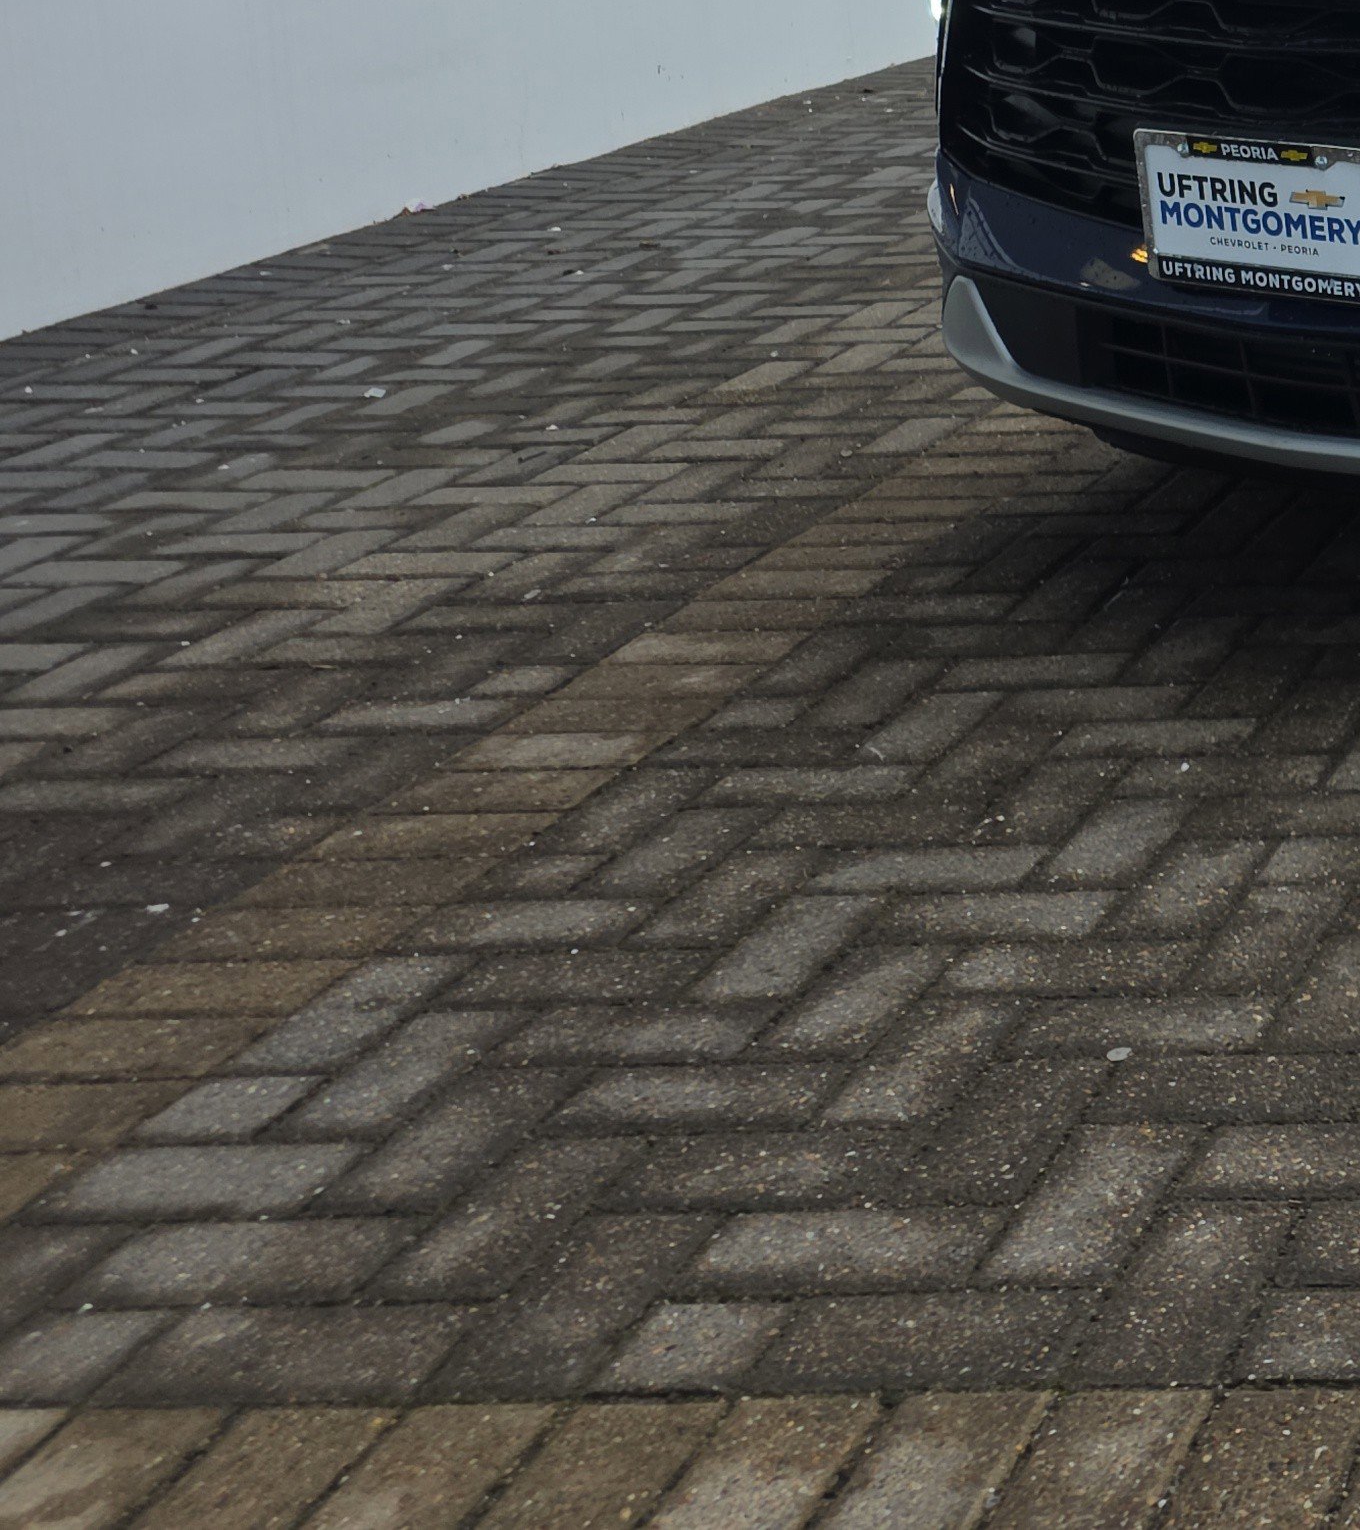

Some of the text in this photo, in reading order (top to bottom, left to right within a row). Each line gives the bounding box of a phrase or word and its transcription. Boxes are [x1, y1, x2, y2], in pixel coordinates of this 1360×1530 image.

[1220, 143, 1279, 161] PEORIA
[1157, 171, 1278, 208] UFTRING
[1209, 236, 1320, 257] CHEVROLET PEORIA
[1162, 260, 1236, 284] UFTRING
